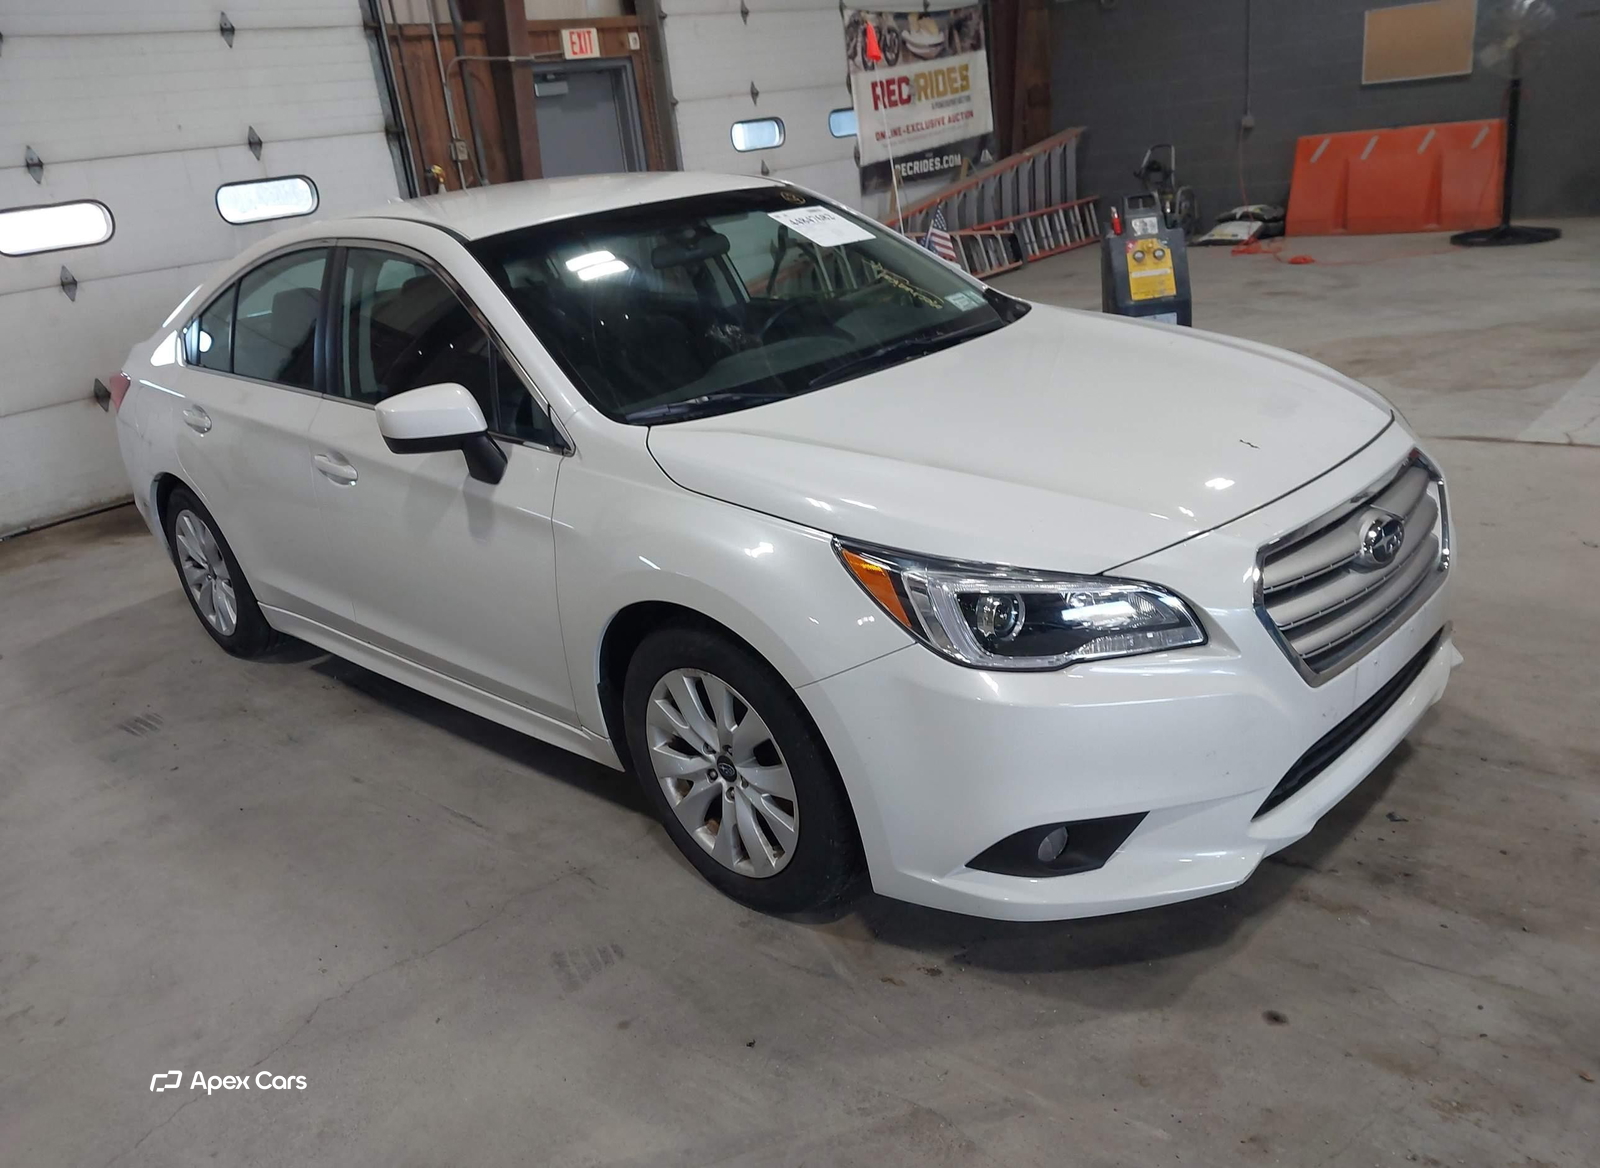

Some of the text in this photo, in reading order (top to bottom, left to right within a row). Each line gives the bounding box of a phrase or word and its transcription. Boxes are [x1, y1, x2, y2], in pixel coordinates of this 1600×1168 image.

[569, 30, 593, 55] EXIT
[871, 76, 912, 110] REC
[914, 63, 971, 102] RIDES
[948, 110, 974, 124] AUCTION
